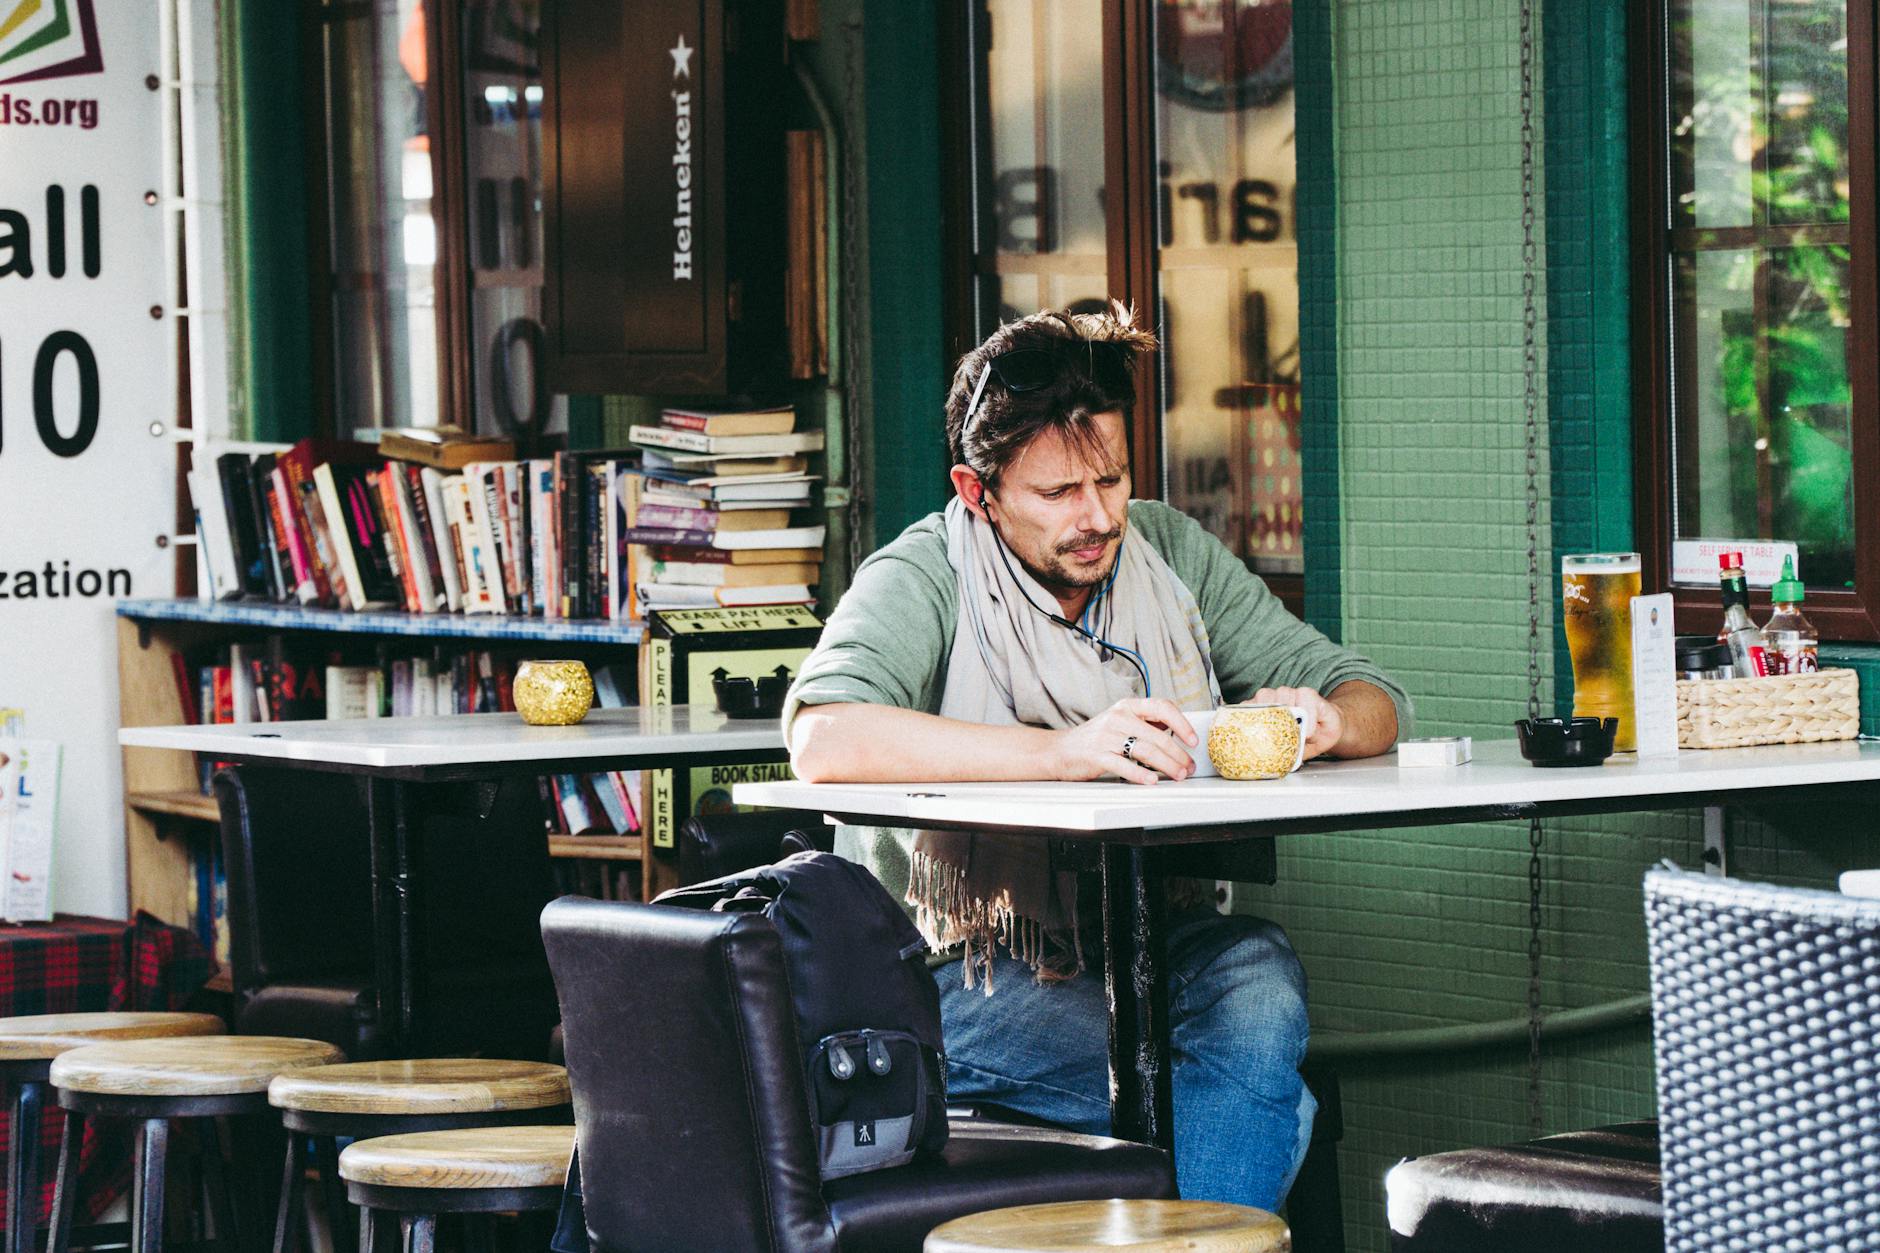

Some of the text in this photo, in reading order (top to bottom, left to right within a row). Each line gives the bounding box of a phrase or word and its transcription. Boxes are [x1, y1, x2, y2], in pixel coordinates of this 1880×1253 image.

[671, 90, 692, 281] Heineken
[1750, 546, 1774, 558] TABLE
[662, 607, 811, 622] PLEASE PAY HERE
[721, 620, 763, 630] LIFT
[711, 762, 792, 785] BOOK STALL
[657, 787, 668, 841] HERE
